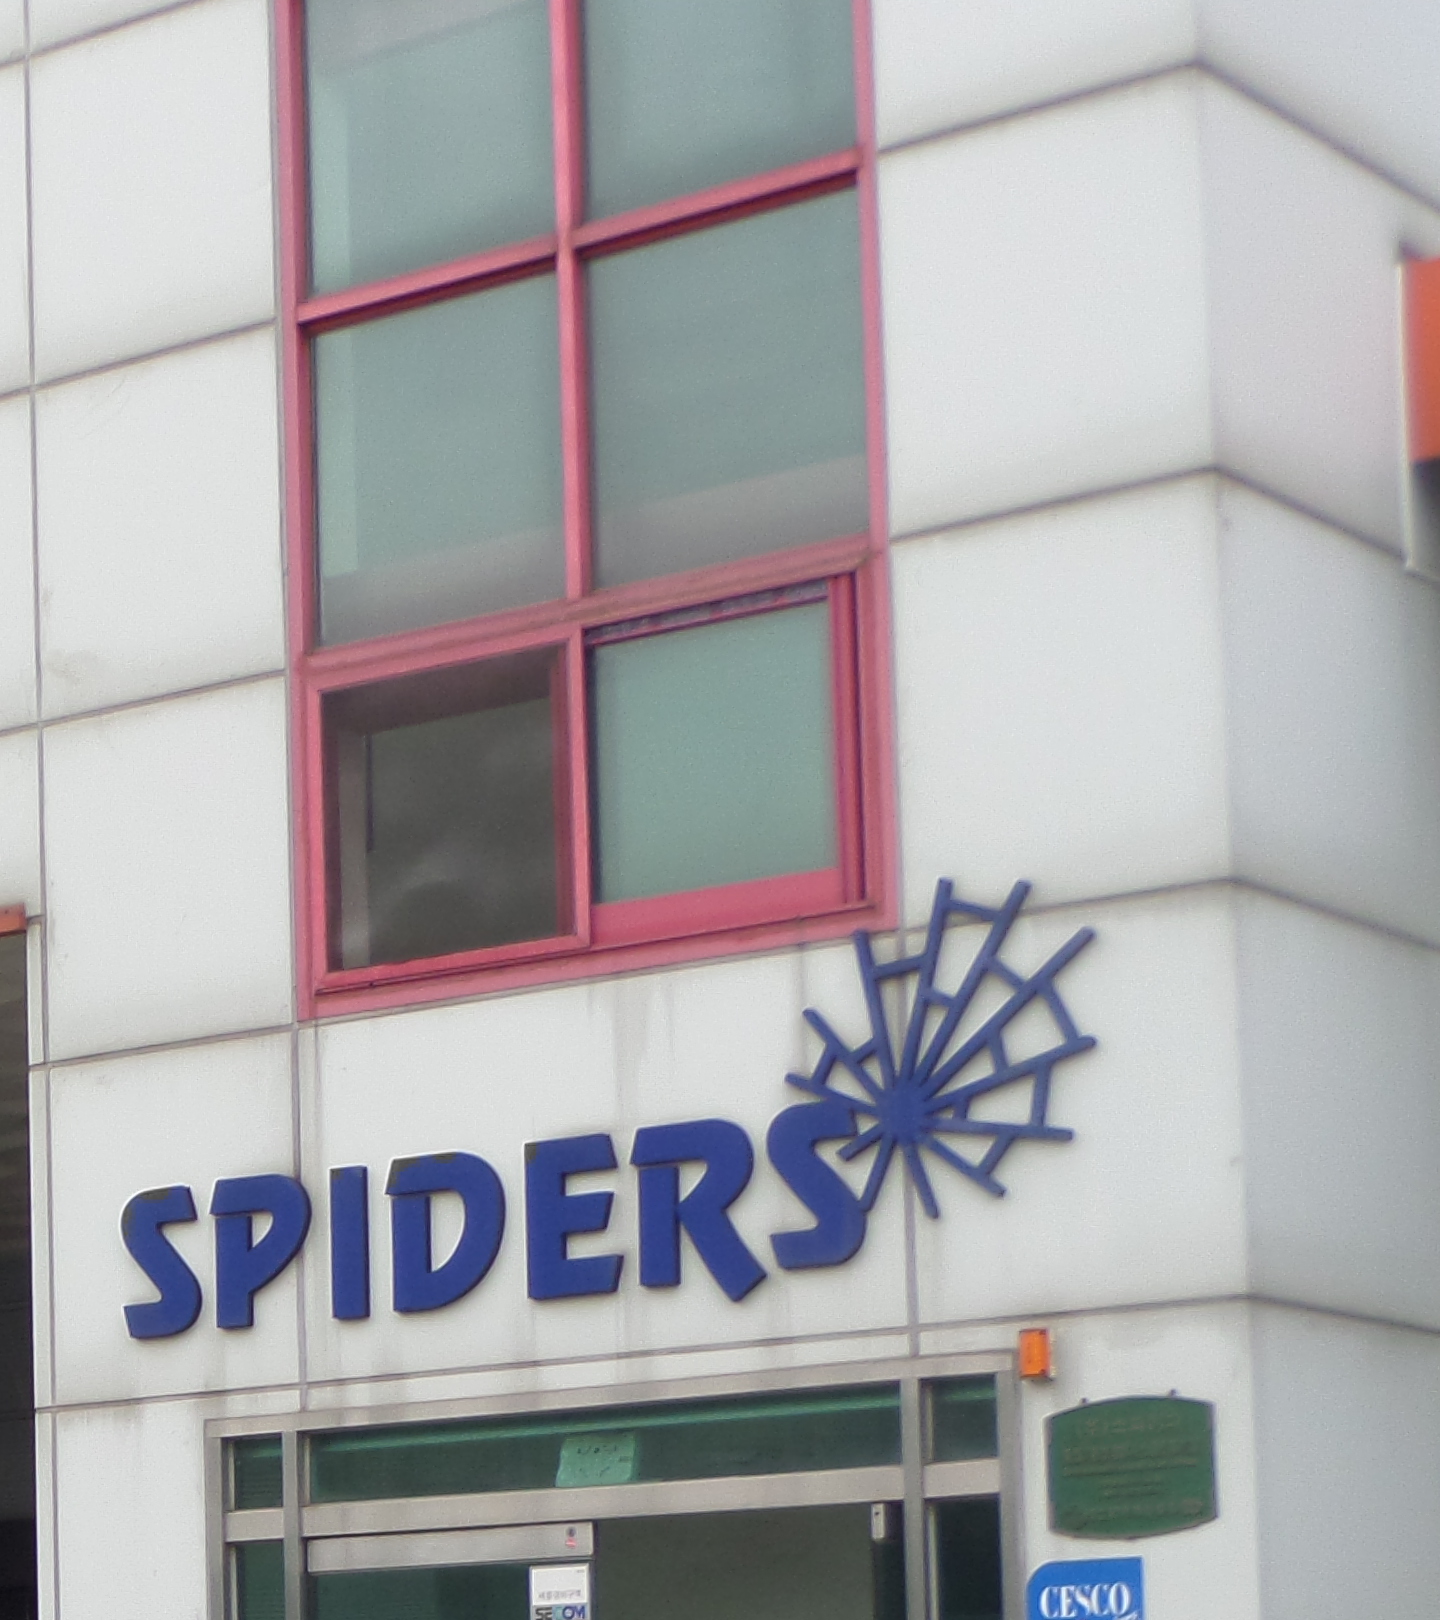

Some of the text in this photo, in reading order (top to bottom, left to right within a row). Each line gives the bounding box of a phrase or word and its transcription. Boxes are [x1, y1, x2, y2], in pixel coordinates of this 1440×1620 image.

[120, 1101, 869, 1338] SPIDERS
[535, 1605, 586, 1620] SECOM
[1040, 1583, 1131, 1618] CESCO
